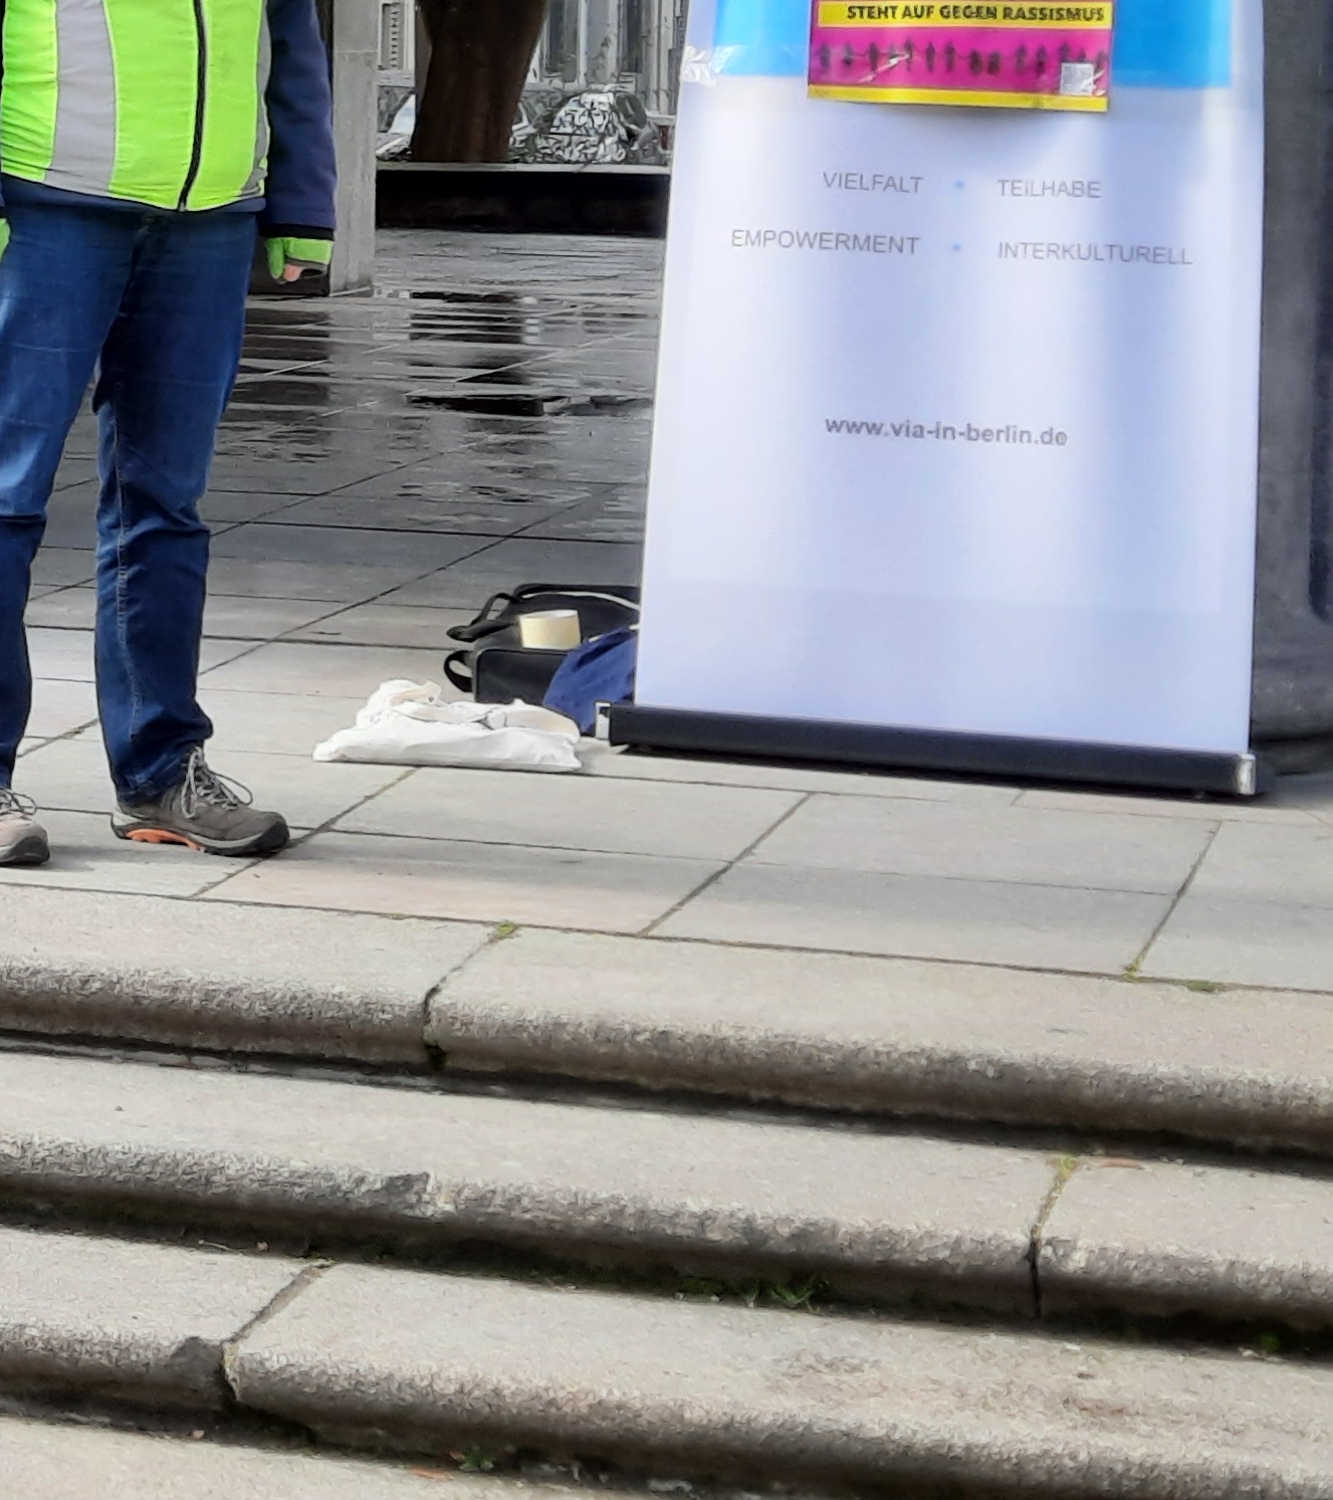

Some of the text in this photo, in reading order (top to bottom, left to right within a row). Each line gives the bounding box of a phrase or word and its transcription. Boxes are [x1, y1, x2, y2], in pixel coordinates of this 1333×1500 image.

[847, 5, 1105, 22] STEHT AUF GEGEN RASSISMUS
[822, 171, 1102, 199] VIELFALT TEILHABE
[731, 229, 1194, 266] EMPOWERMENT INTERKULTURELL
[824, 418, 1069, 446] www.via-in-berlin.de
